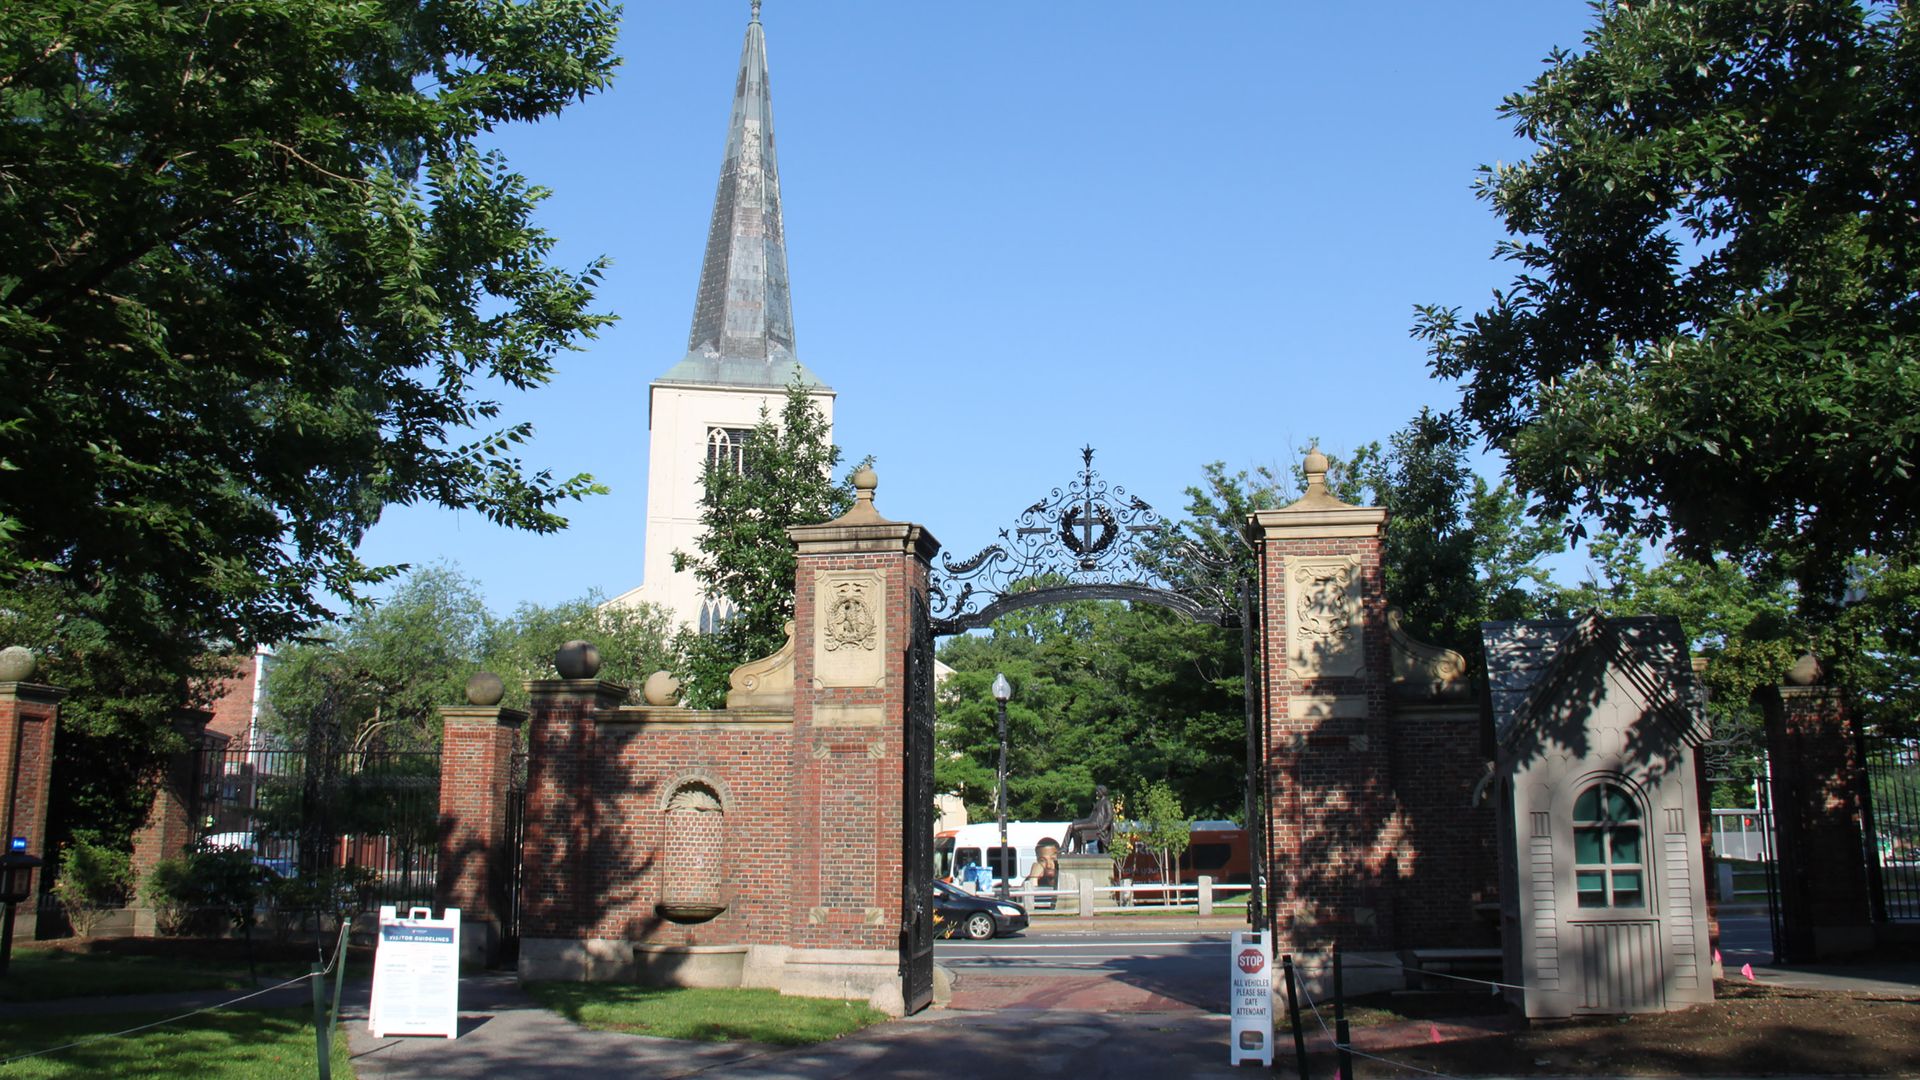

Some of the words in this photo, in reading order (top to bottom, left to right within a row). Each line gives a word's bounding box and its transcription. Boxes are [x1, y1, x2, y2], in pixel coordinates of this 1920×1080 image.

[1239, 956, 1263, 967] STOP
[1234, 979, 1243, 987] ALL
[1244, 979, 1269, 987] VEHICLES
[1236, 988, 1255, 996] PLEASE
[1256, 988, 1267, 996] SEE
[1236, 1008, 1266, 1016] ATTENDANT
